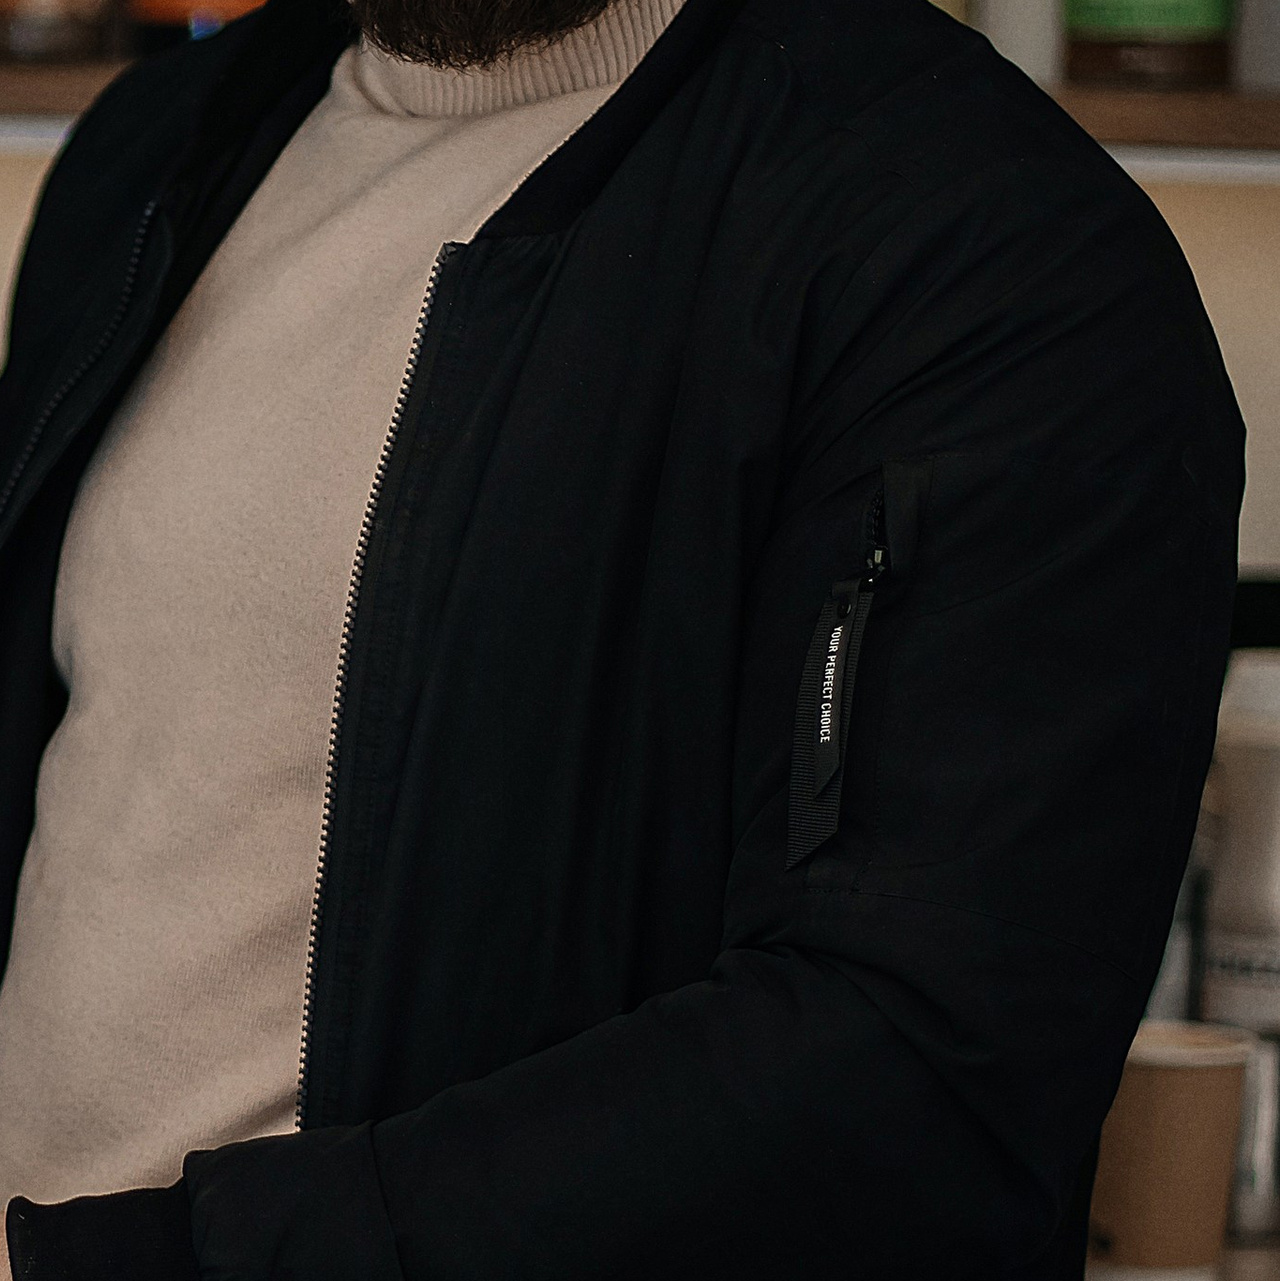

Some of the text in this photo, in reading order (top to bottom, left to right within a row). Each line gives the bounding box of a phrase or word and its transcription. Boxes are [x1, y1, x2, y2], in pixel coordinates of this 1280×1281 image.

[819, 625, 844, 743] YOUR PERFECT CHOICE
